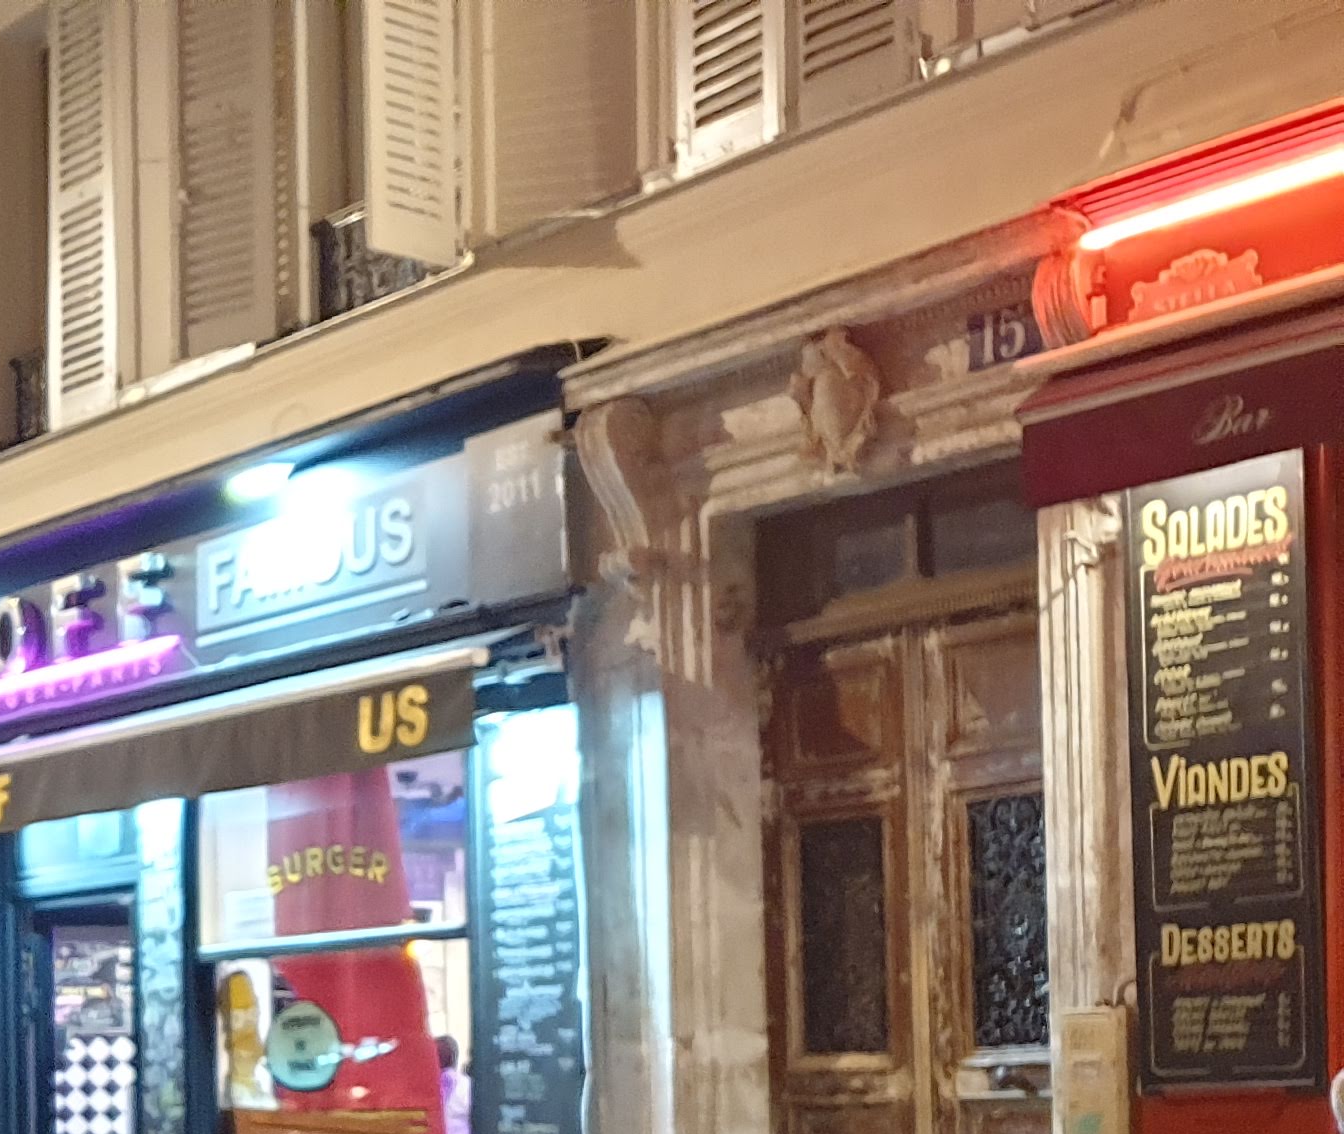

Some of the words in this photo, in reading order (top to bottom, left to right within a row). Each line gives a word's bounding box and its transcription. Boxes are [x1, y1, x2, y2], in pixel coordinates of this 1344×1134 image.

[982, 307, 1027, 362] 15
[1193, 393, 1272, 446] Bar
[208, 498, 414, 614] FAUS
[357, 684, 430, 754] US
[267, 844, 391, 896] BURGER
[1161, 919, 1296, 967] DESSERTS
